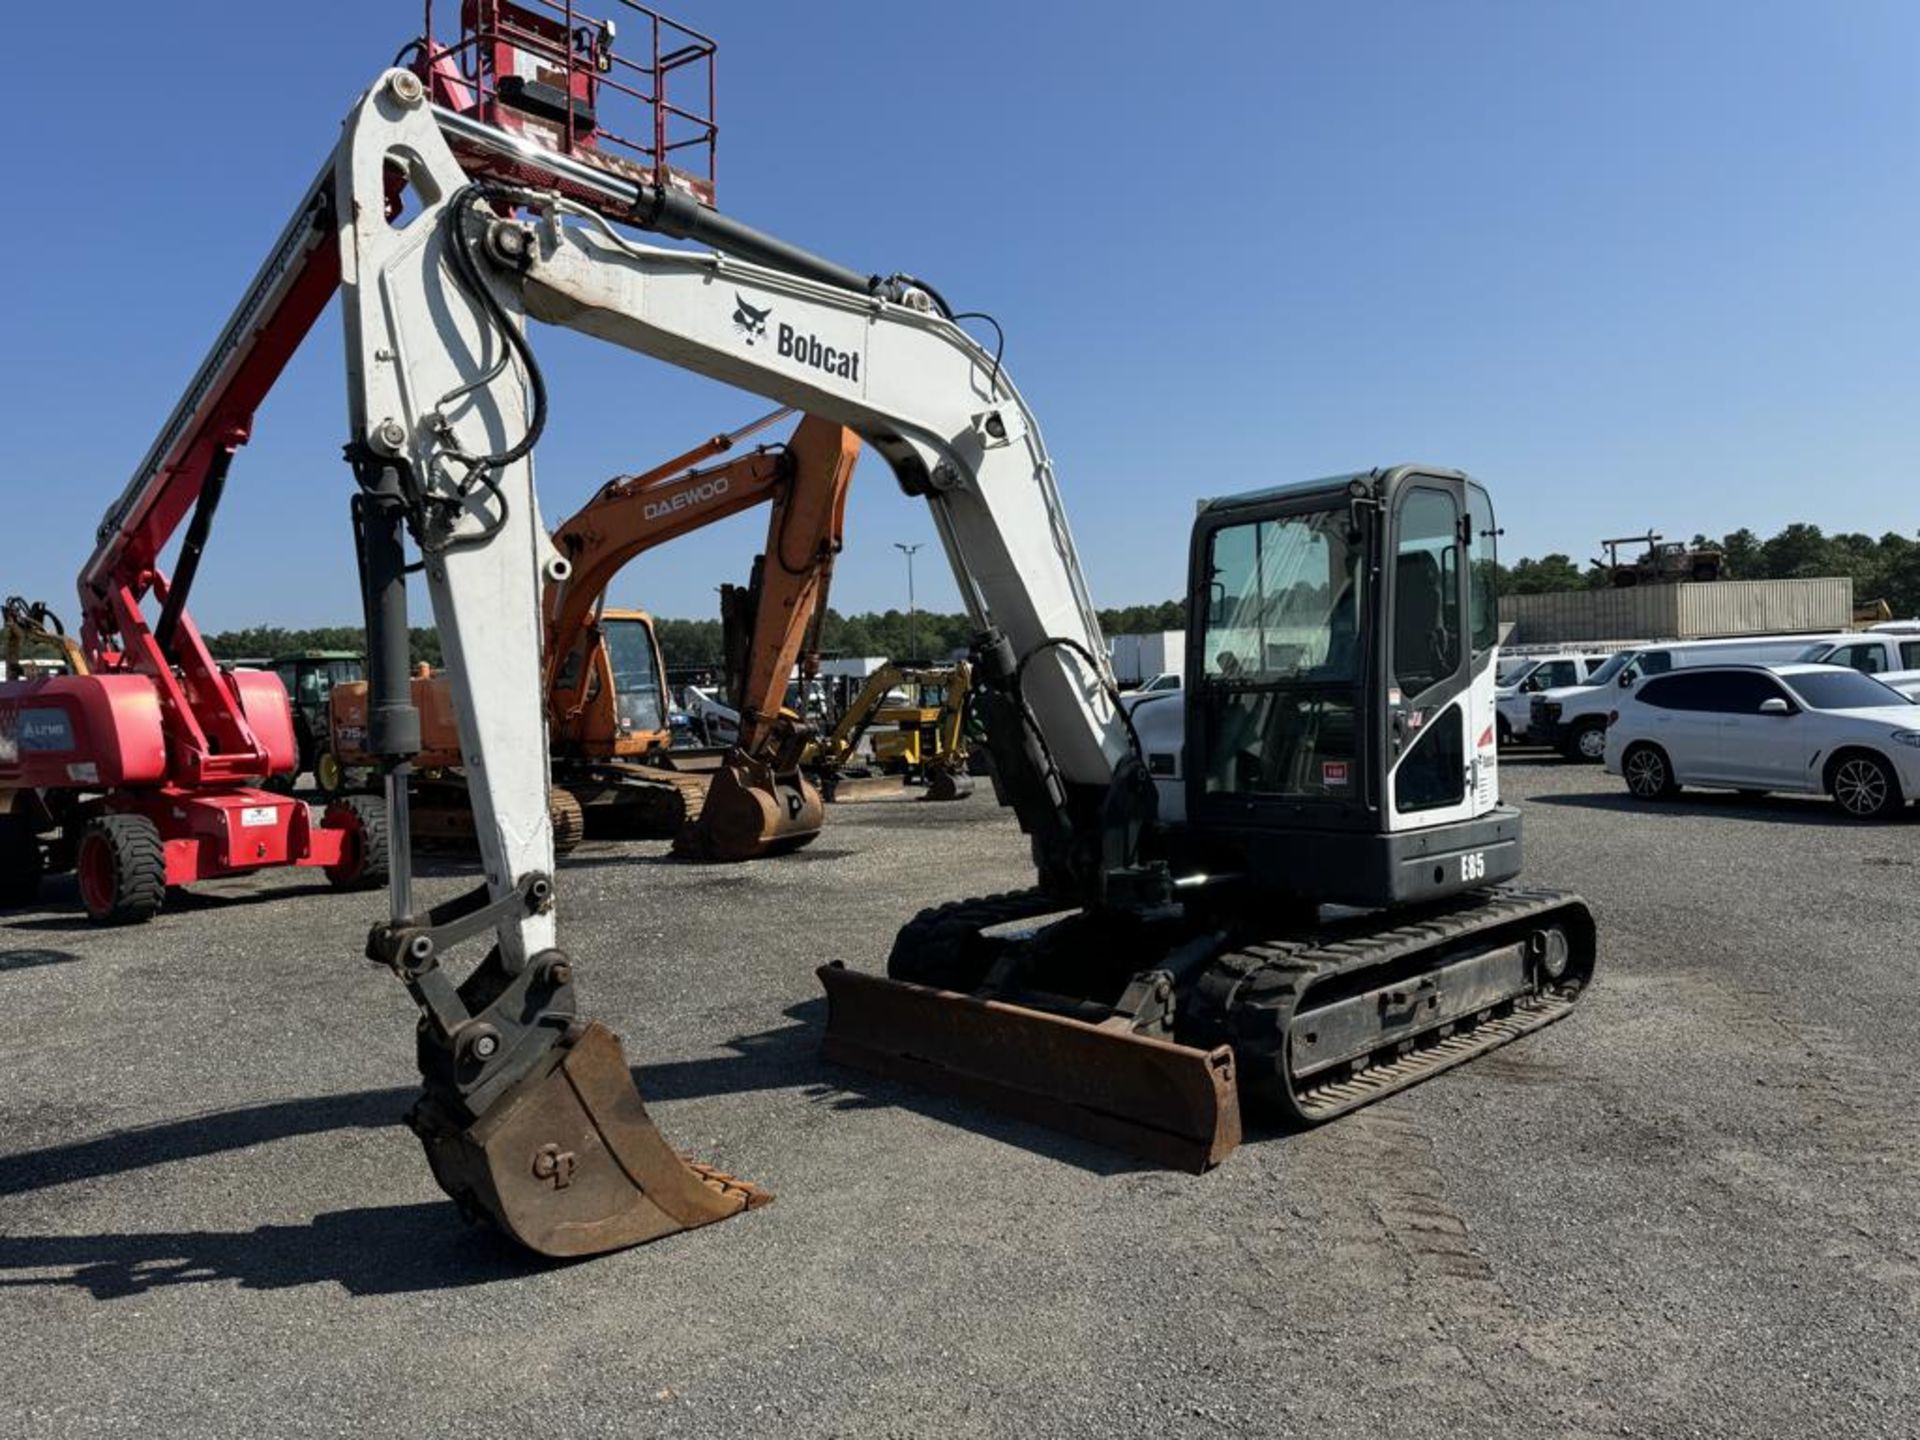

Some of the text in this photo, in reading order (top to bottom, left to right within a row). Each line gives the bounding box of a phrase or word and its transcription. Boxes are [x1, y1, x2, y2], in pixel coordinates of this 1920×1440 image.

[778, 322, 859, 382] Bobcat
[644, 477, 729, 520] DAEWOO
[1461, 853, 1485, 881] E85
